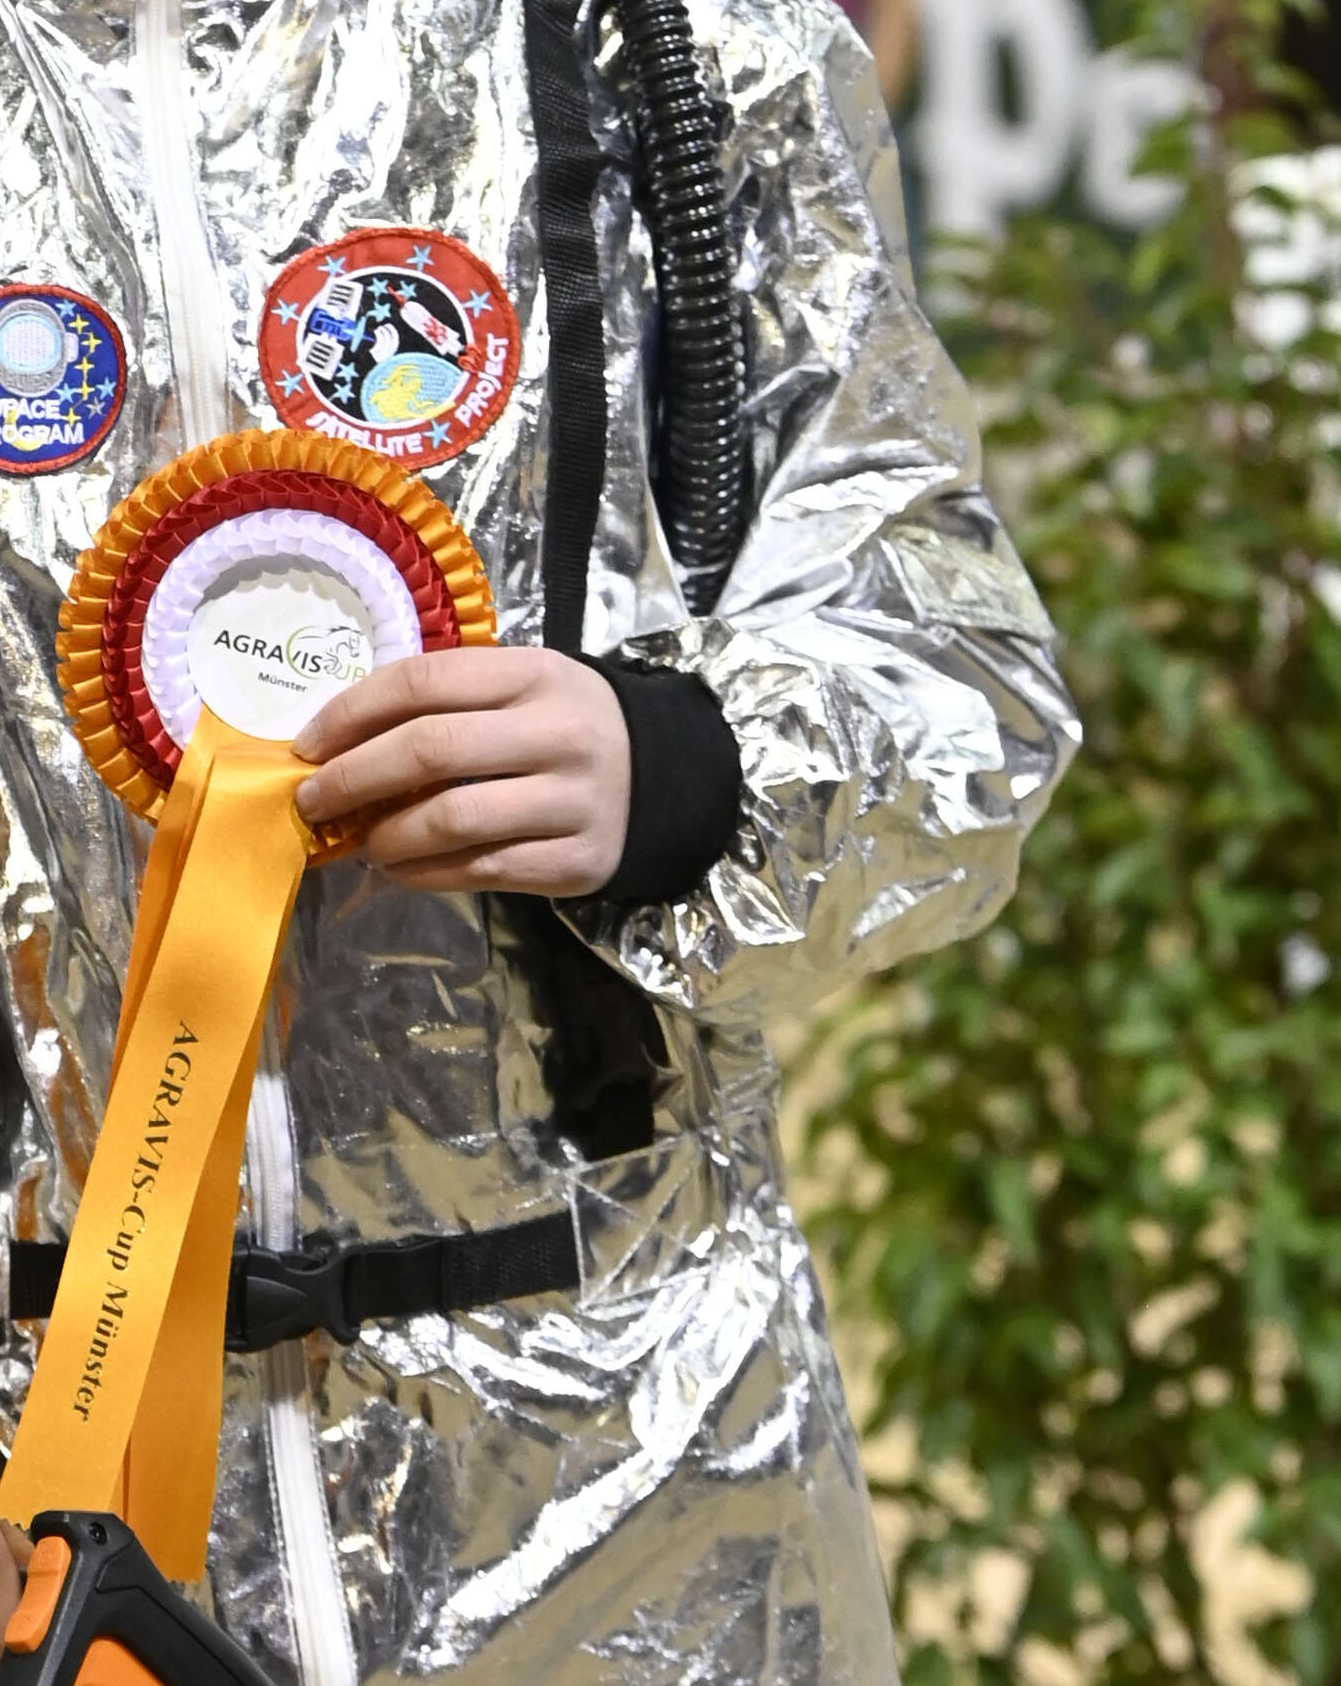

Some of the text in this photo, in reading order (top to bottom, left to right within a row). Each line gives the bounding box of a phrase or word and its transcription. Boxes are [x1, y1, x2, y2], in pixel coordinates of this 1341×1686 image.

[454, 333, 510, 428] PROJECT
[305, 411, 424, 457] SATELLITE
[213, 629, 323, 673] AGRAVIS
[258, 672, 308, 693] Münster
[74, 1019, 199, 1423] AGRAVIS-Cup Münster
